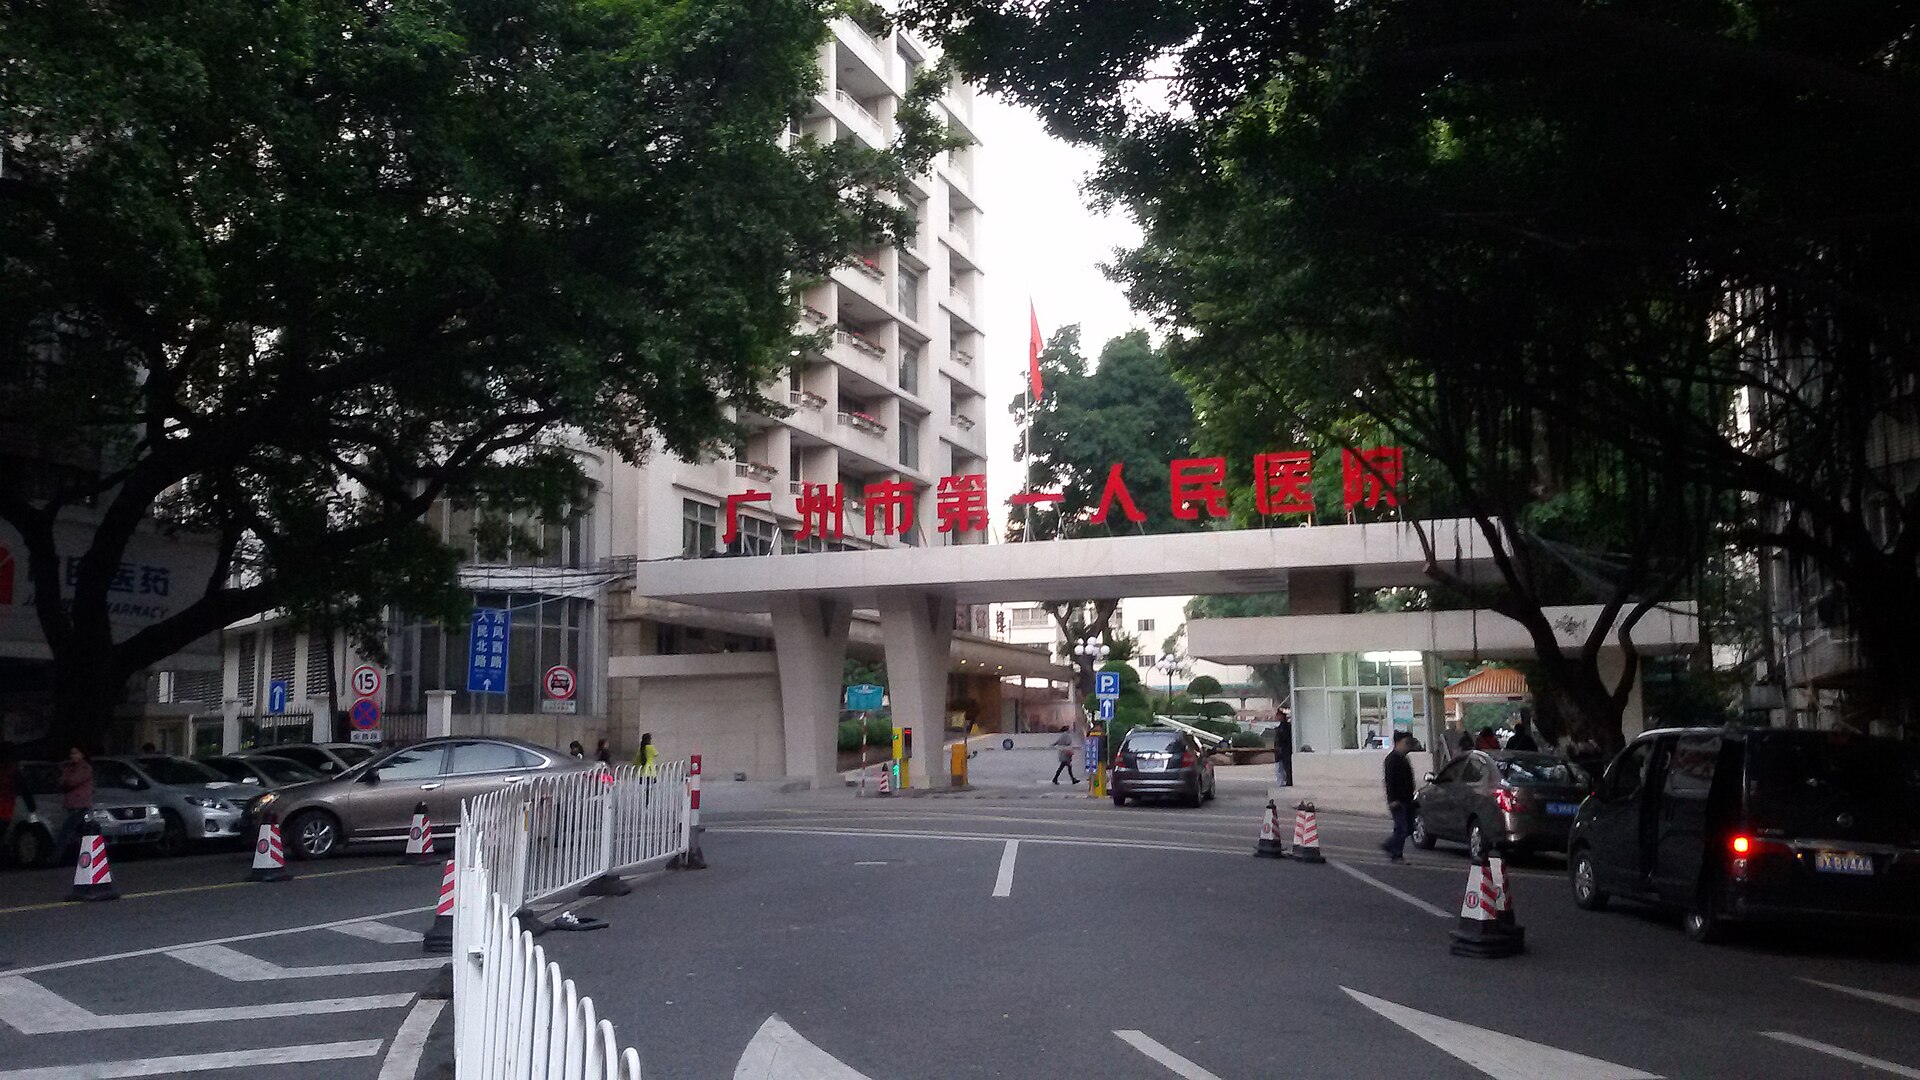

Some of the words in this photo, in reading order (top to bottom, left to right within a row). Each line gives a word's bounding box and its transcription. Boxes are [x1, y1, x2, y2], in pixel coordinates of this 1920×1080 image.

[723, 446, 1403, 545] 广州市第一人民医院
[474, 610, 489, 668] 人民北路
[359, 673, 374, 690] 15
